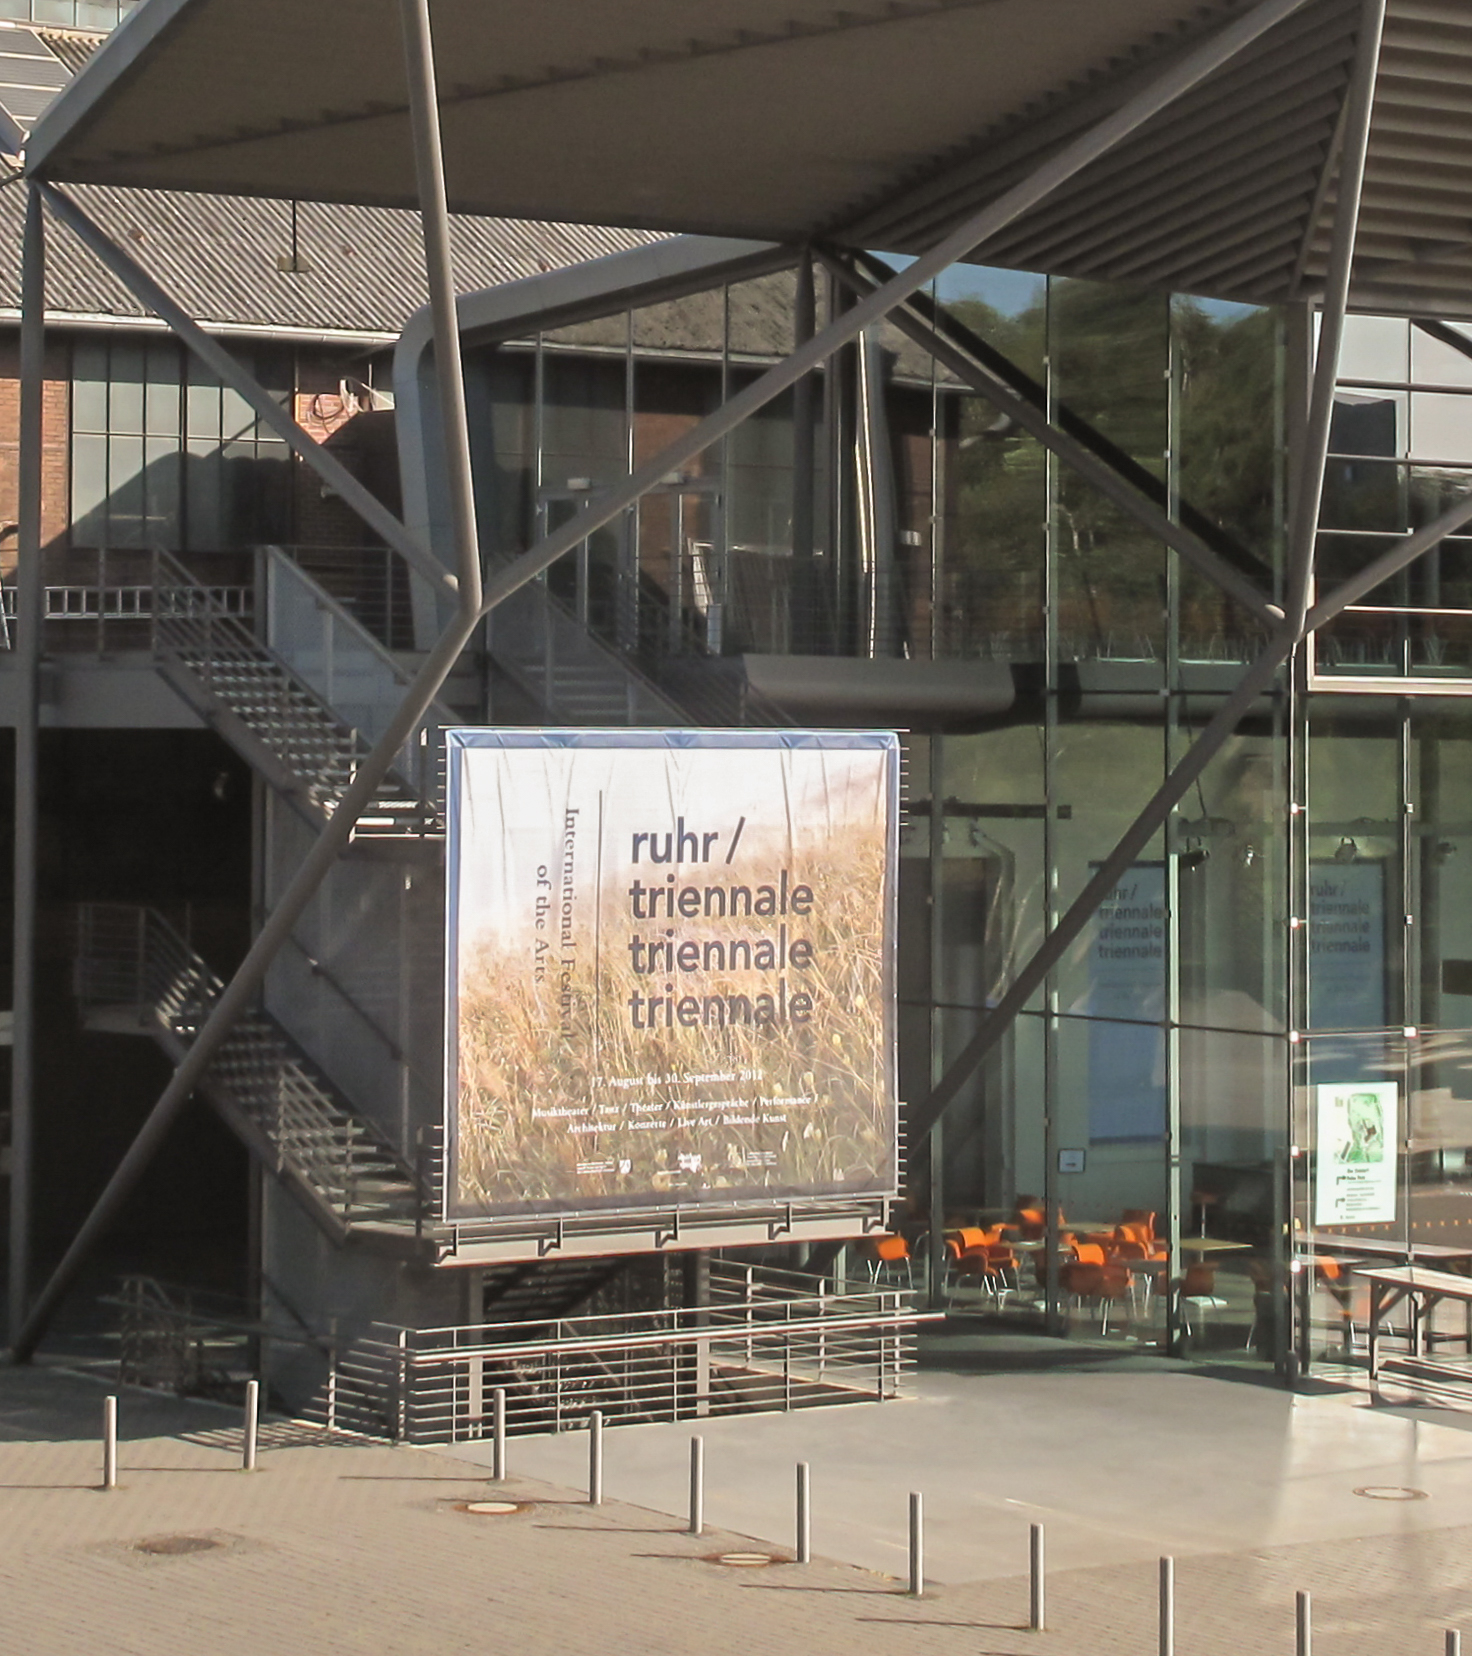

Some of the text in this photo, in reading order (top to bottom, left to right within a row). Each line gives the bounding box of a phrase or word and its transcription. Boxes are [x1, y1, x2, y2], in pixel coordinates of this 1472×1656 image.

[632, 816, 719, 864] ruhr
[628, 869, 814, 919] triennale
[534, 864, 552, 984] of the Arts
[560, 808, 580, 1038] International Festival
[628, 923, 813, 974] triennale
[1098, 941, 1162, 959] triennale
[628, 977, 813, 1029] triennale
[608, 1074, 644, 1090] August
[647, 1071, 661, 1085] bis
[683, 1069, 736, 1087] September
[697, 1115, 713, 1127] Art
[762, 1112, 787, 1124] Kunst
